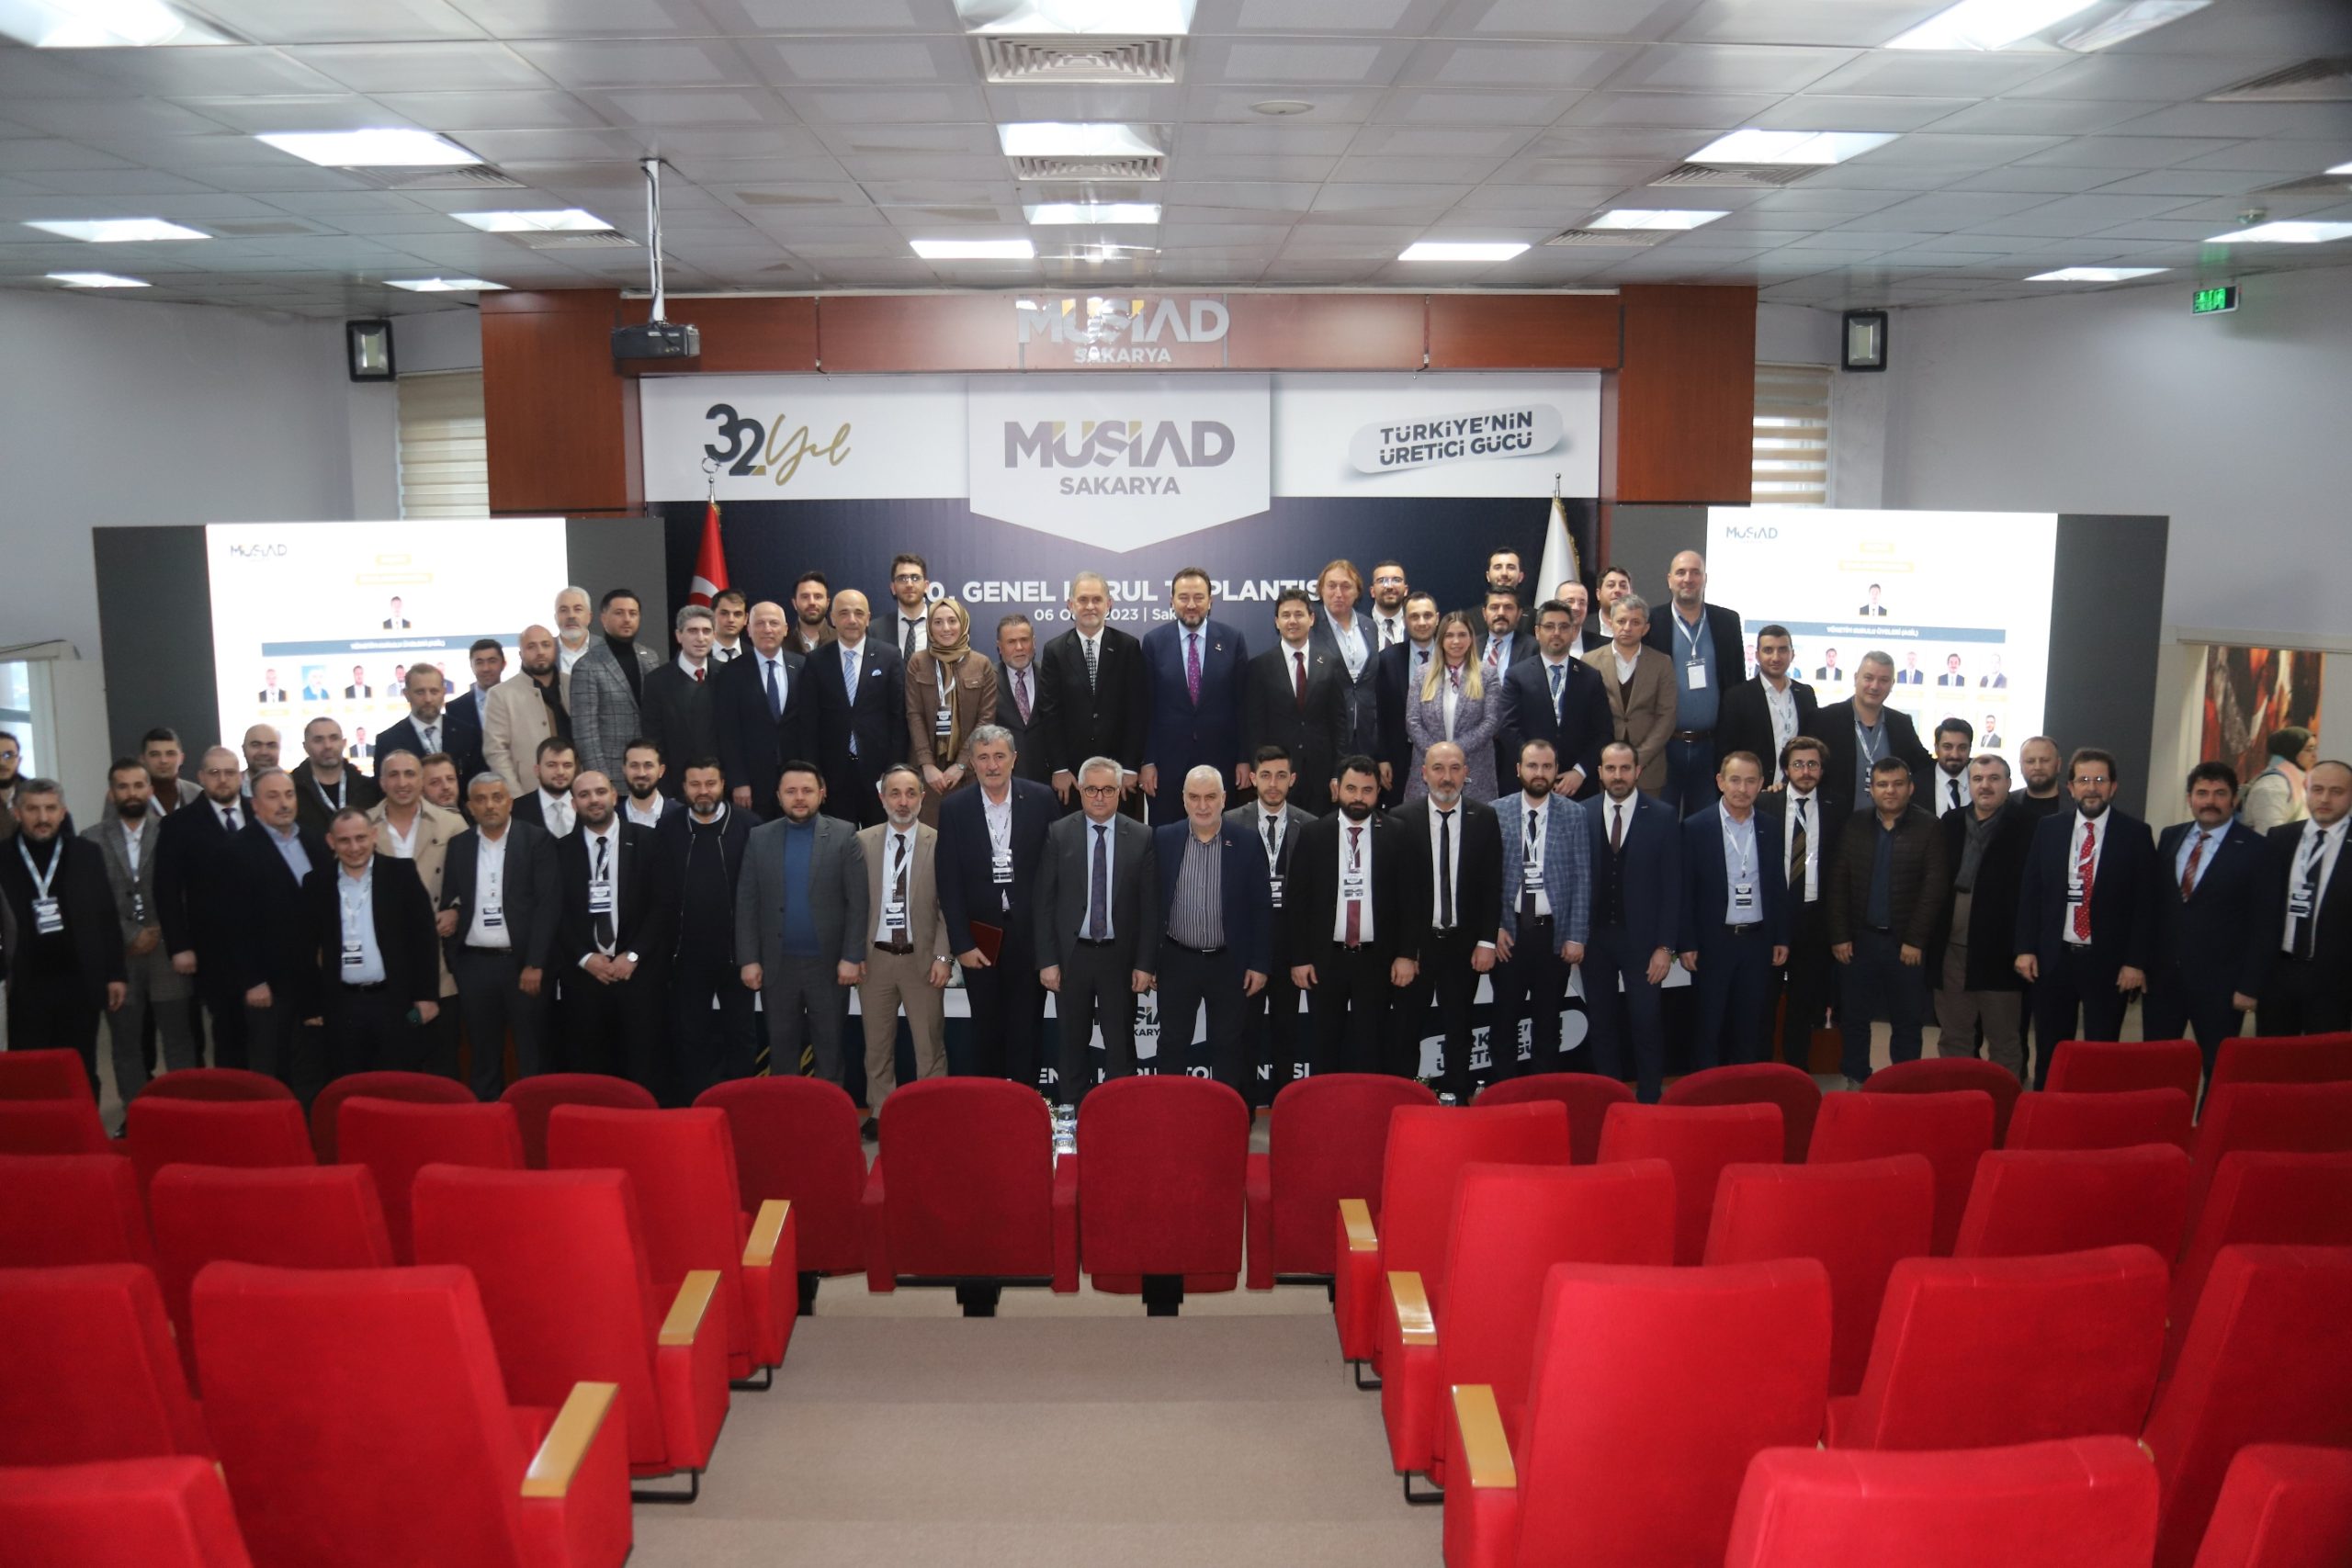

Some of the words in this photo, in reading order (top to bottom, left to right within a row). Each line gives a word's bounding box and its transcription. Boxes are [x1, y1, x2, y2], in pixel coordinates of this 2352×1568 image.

[1074, 347, 1172, 363] SAKARYA
[1470, 432, 1532, 455] GÜCÜ
[1059, 477, 1182, 495] SAKARYA
[962, 581, 1057, 603] GENEL
[1064, 581, 1158, 602] RUL
[1035, 608, 1054, 621] 06
